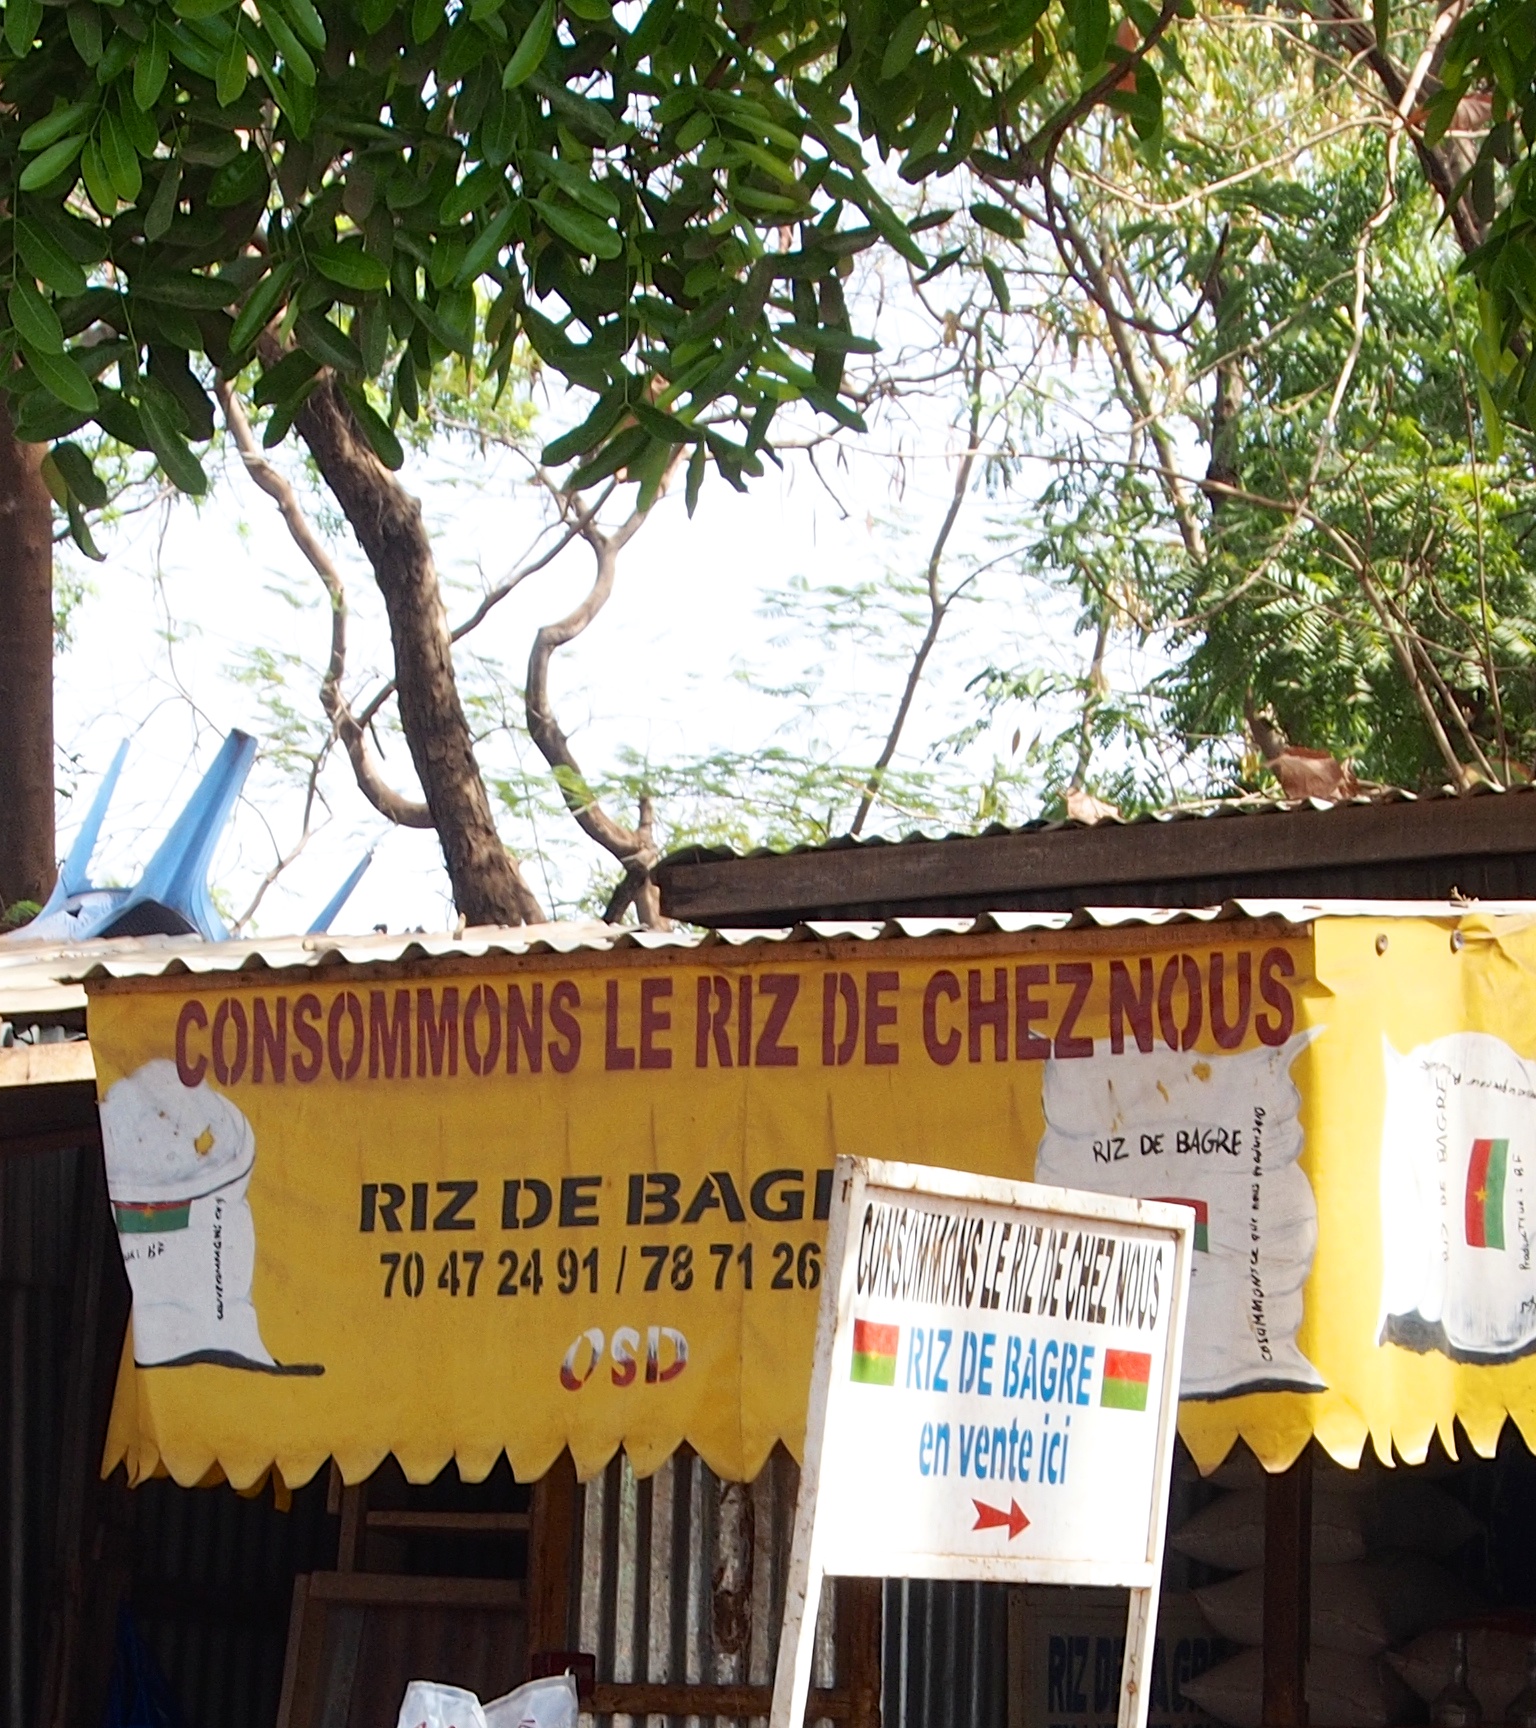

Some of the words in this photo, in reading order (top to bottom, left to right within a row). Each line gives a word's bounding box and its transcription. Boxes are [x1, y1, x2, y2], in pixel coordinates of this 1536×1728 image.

[175, 979, 582, 1087] CONSOMMONS
[605, 975, 672, 1071] LE
[695, 973, 800, 1068] RIZ
[822, 970, 900, 1066] DE
[923, 963, 1093, 1066] CHEZ
[1109, 947, 1295, 1053] NOUS
[1093, 1137, 1129, 1163] RIZ
[1140, 1134, 1164, 1155] DE
[1176, 1127, 1242, 1156] BAGRE
[359, 1180, 475, 1233] RIZ
[501, 1174, 600, 1229] DE
[625, 1169, 836, 1226] BAG
[382, 1250, 424, 1298] 70
[437, 1248, 485, 1296] 47
[497, 1248, 544, 1296] 24
[556, 1247, 599, 1294] 91
[615, 1246, 627, 1294] /
[641, 1245, 693, 1292] 78
[712, 1243, 752, 1291] 71
[771, 1241, 821, 1290] 26
[857, 1202, 983, 1310] CONSOMMONS
[979, 1220, 1012, 1310] LE
[1006, 1222, 1038, 1315] RIZ
[1037, 1230, 1069, 1317] DE
[1066, 1232, 1113, 1324] CHEZ
[1112, 1241, 1163, 1330] NOUS
[560, 1324, 688, 1392] OSD
[907, 1327, 951, 1392] RIZ
[958, 1331, 996, 1397] DE
[1002, 1335, 1095, 1406] BAGRE
[919, 1420, 950, 1477] en
[959, 1417, 1033, 1482] vente
[1039, 1413, 1071, 1485] ici
[1049, 1636, 1089, 1713] RIZ
